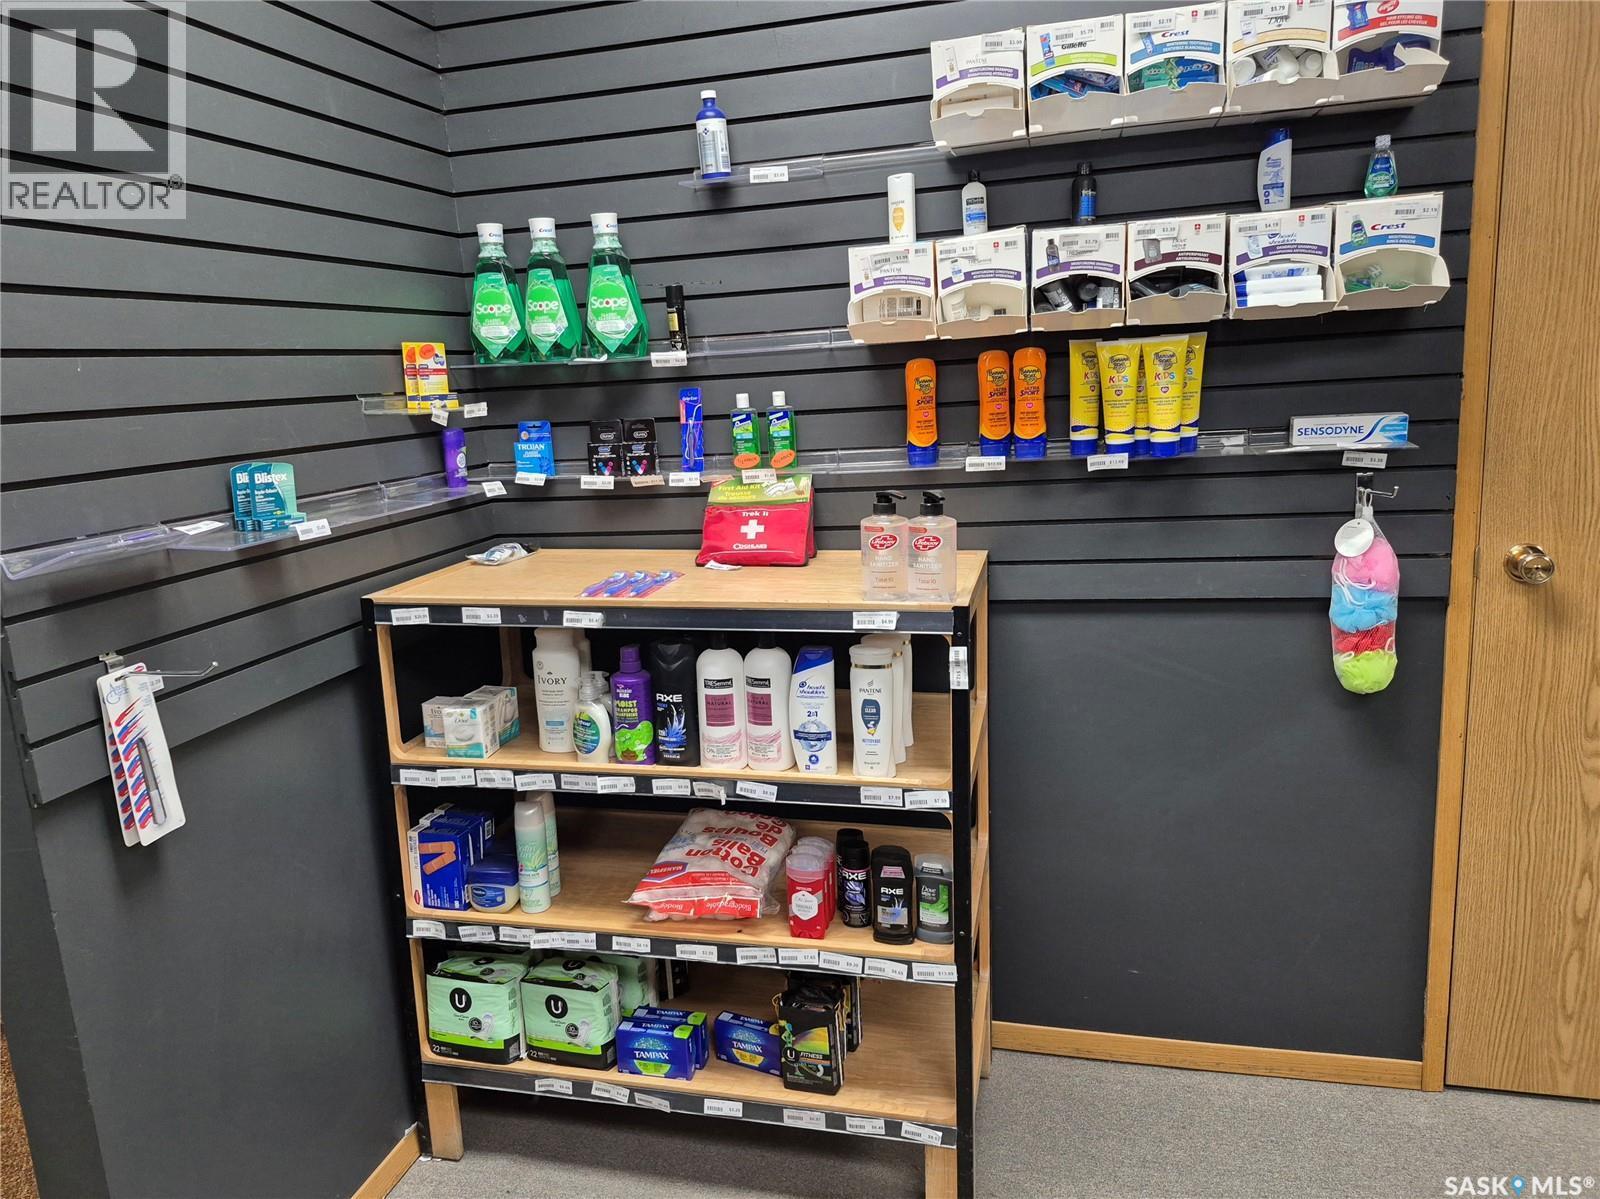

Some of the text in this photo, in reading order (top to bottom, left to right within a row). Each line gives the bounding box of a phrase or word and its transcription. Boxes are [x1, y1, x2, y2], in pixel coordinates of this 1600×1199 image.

[1161, 30, 1190, 38] Crest
[1061, 41, 1088, 50] Gillette
[1370, 222, 1406, 230] Crest
[476, 302, 512, 317] Scope
[528, 300, 559, 314] Scope
[592, 297, 628, 312] Scope
[1108, 375, 1128, 384] KIDS
[1154, 372, 1176, 382] KIDS
[1020, 390, 1040, 398] SPORT
[1297, 425, 1364, 436] SENSODYNE
[254, 472, 288, 484] Blistex
[538, 674, 568, 686] IVORY
[656, 693, 683, 702] AXE
[614, 700, 638, 708] MOIST
[702, 826, 779, 848] Boules
[712, 838, 768, 866] Balls
[684, 848, 760, 879] Cotton
[842, 872, 867, 880] AXE
[880, 887, 904, 896] AXE
[732, 1040, 763, 1053] TAMPAX
[634, 1050, 669, 1060] TAMPAX
[800, 1052, 823, 1060] FITNESS
